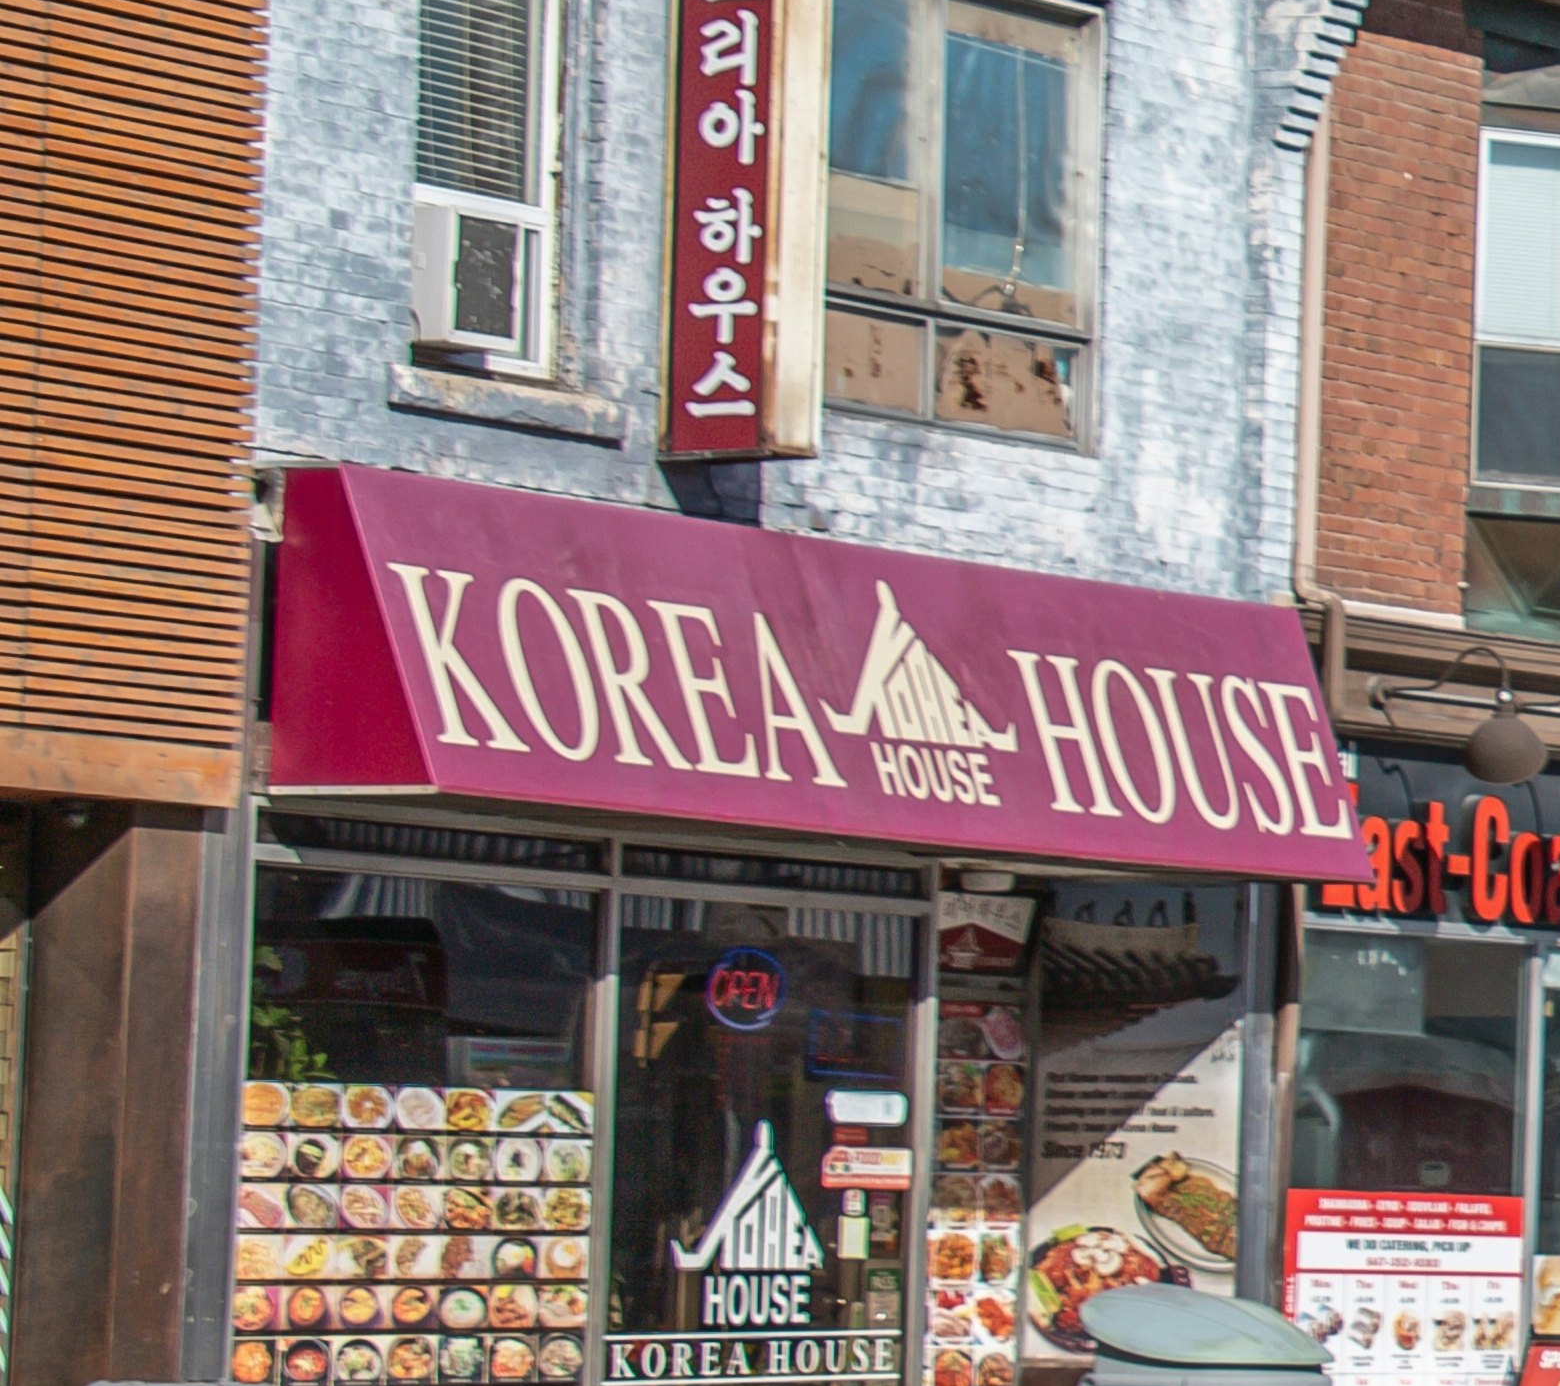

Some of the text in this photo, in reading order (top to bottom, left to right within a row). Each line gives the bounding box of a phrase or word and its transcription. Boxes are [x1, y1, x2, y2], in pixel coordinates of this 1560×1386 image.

[686, 188, 764, 417] 하우스
[387, 561, 1354, 841] KOREA HOUSE
[870, 740, 998, 808] HOUSE
[710, 969, 781, 1012] OPEN
[703, 1274, 811, 1326] HOUSE
[609, 1338, 895, 1380] KOREA HOUSE
